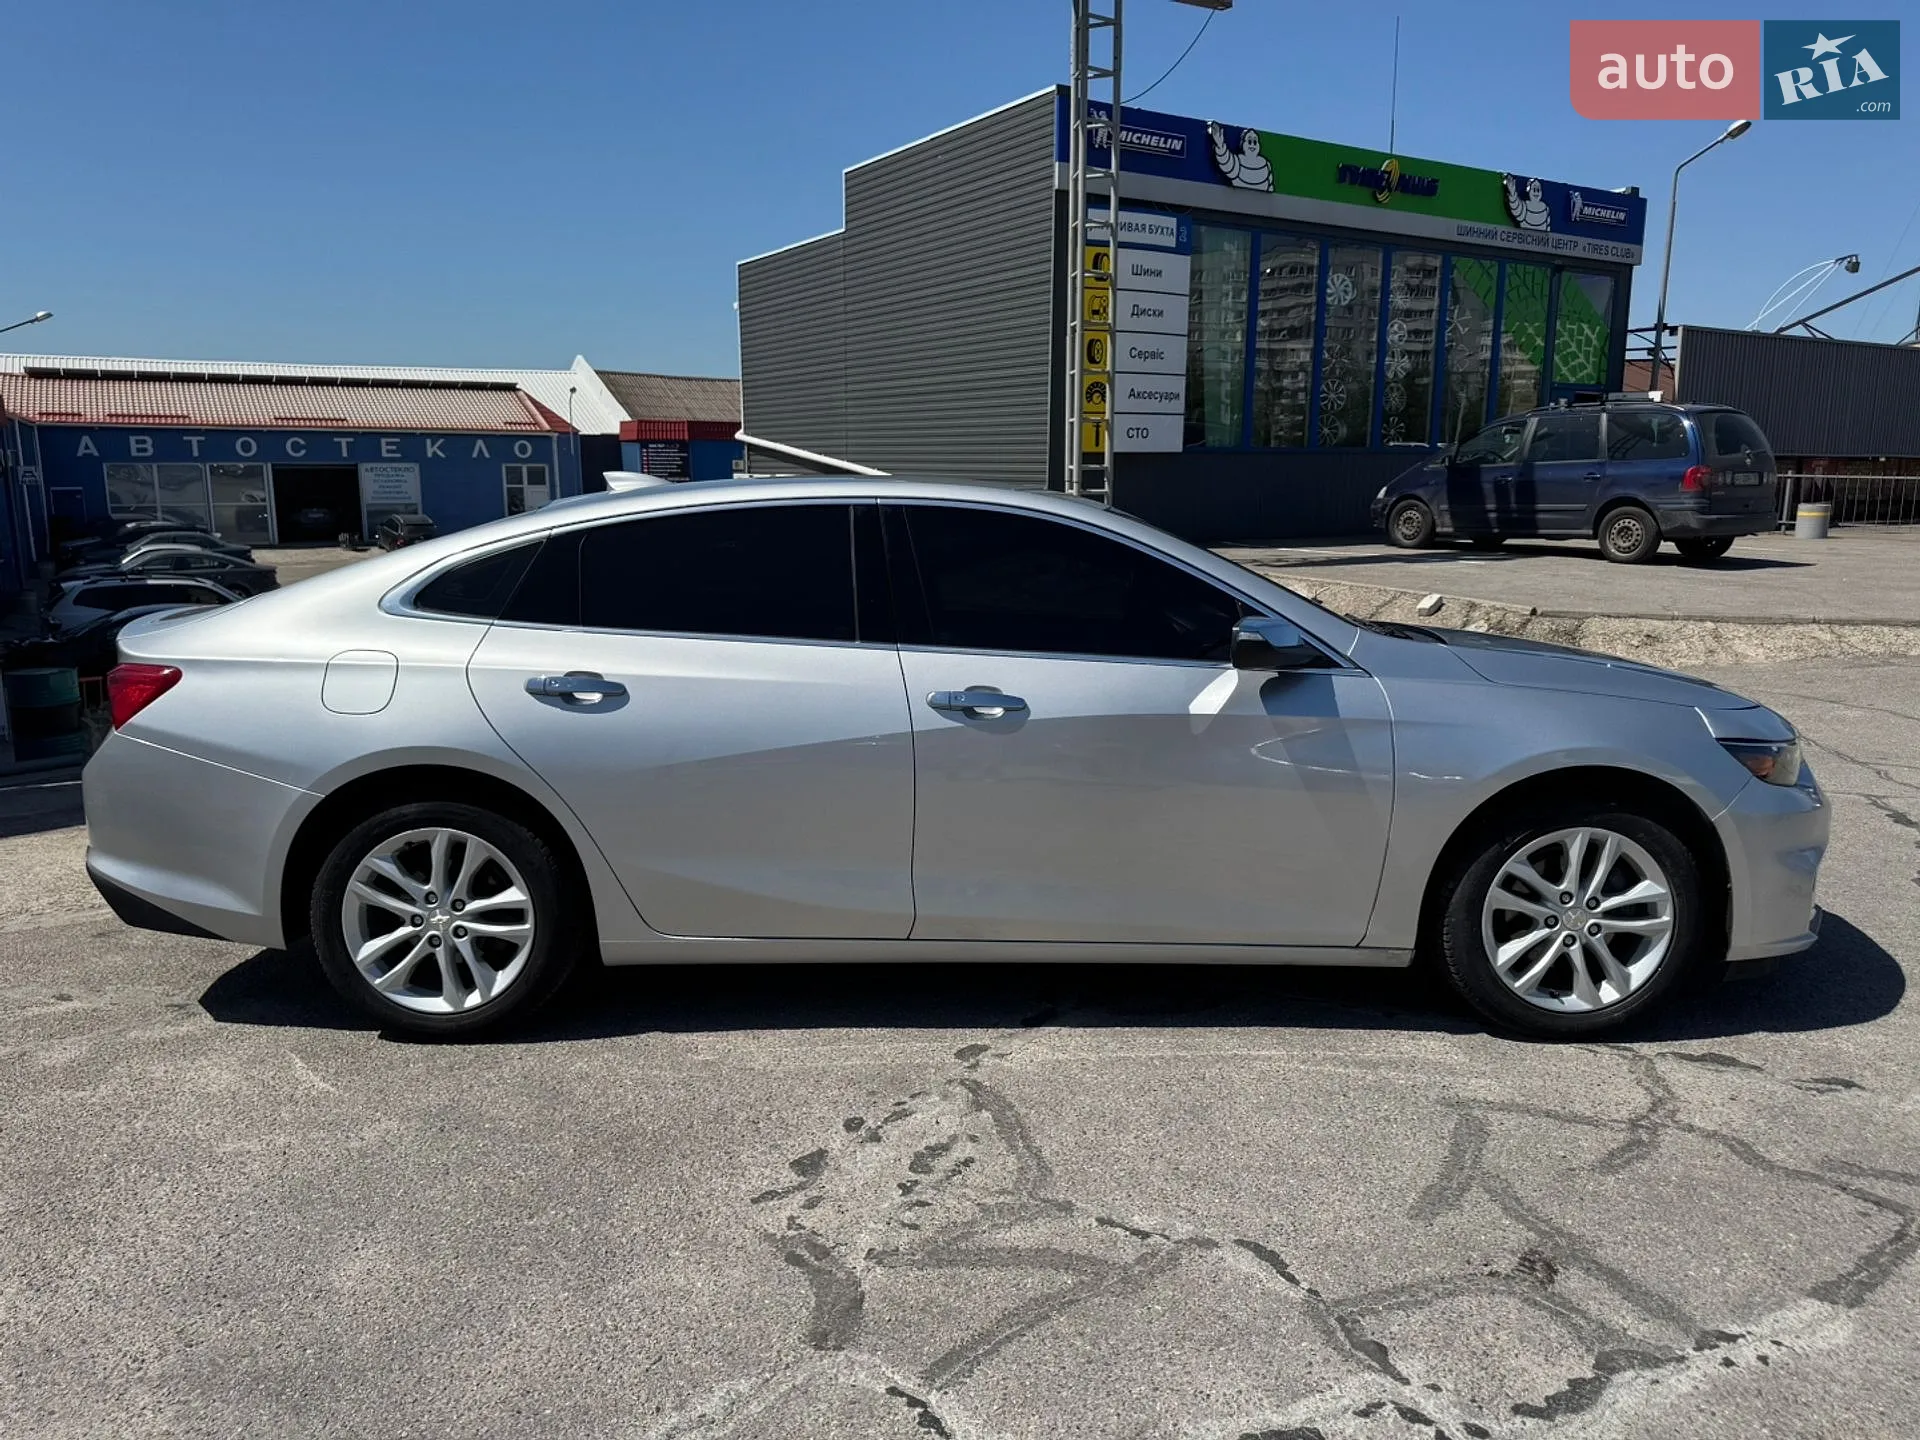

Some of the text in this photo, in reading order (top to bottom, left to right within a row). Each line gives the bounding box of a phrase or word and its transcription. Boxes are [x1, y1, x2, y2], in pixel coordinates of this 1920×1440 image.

[1118, 130, 1183, 150] MICHELIN
[1582, 206, 1626, 221] MICHELIN
[1147, 224, 1175, 238] БУХТА
[1456, 224, 1498, 241] ШИННИЙ
[1499, 230, 1550, 248] СЕРВІСНИЙ
[1551, 237, 1579, 252] ЦЕНТР
[1130, 263, 1163, 279] Шини
[1130, 304, 1164, 319] Диски
[1128, 346, 1165, 361] Сервіс
[1127, 387, 1181, 403] Аксесуари
[1126, 427, 1149, 440] СТО
[76, 434, 533, 459] АВТОСТЕКЛО
